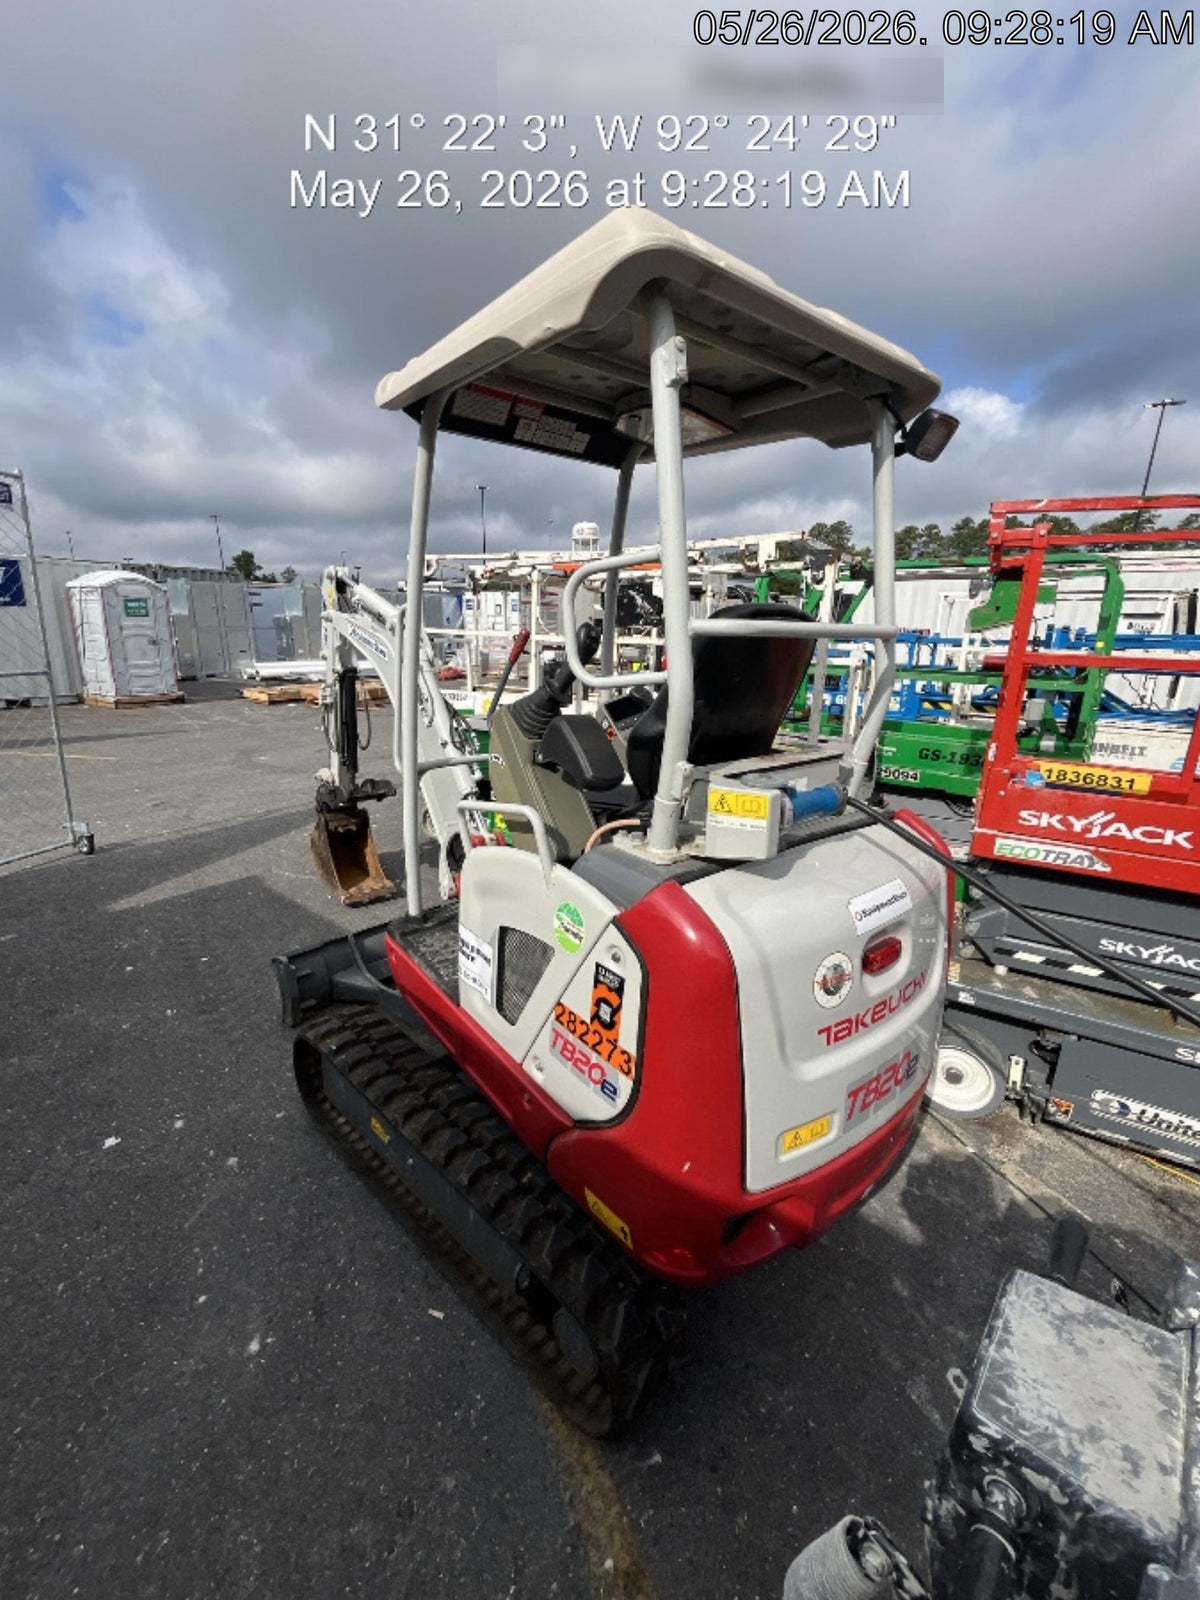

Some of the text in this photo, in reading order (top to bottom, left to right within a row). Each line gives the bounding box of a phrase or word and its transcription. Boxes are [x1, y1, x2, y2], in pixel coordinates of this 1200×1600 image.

[918, 747, 985, 768] GS-193
[1044, 767, 1136, 791] 1836831
[1018, 810, 1195, 849] SKYJACK
[555, 1002, 632, 1076] 282273
[552, 1026, 618, 1103] TB20e
